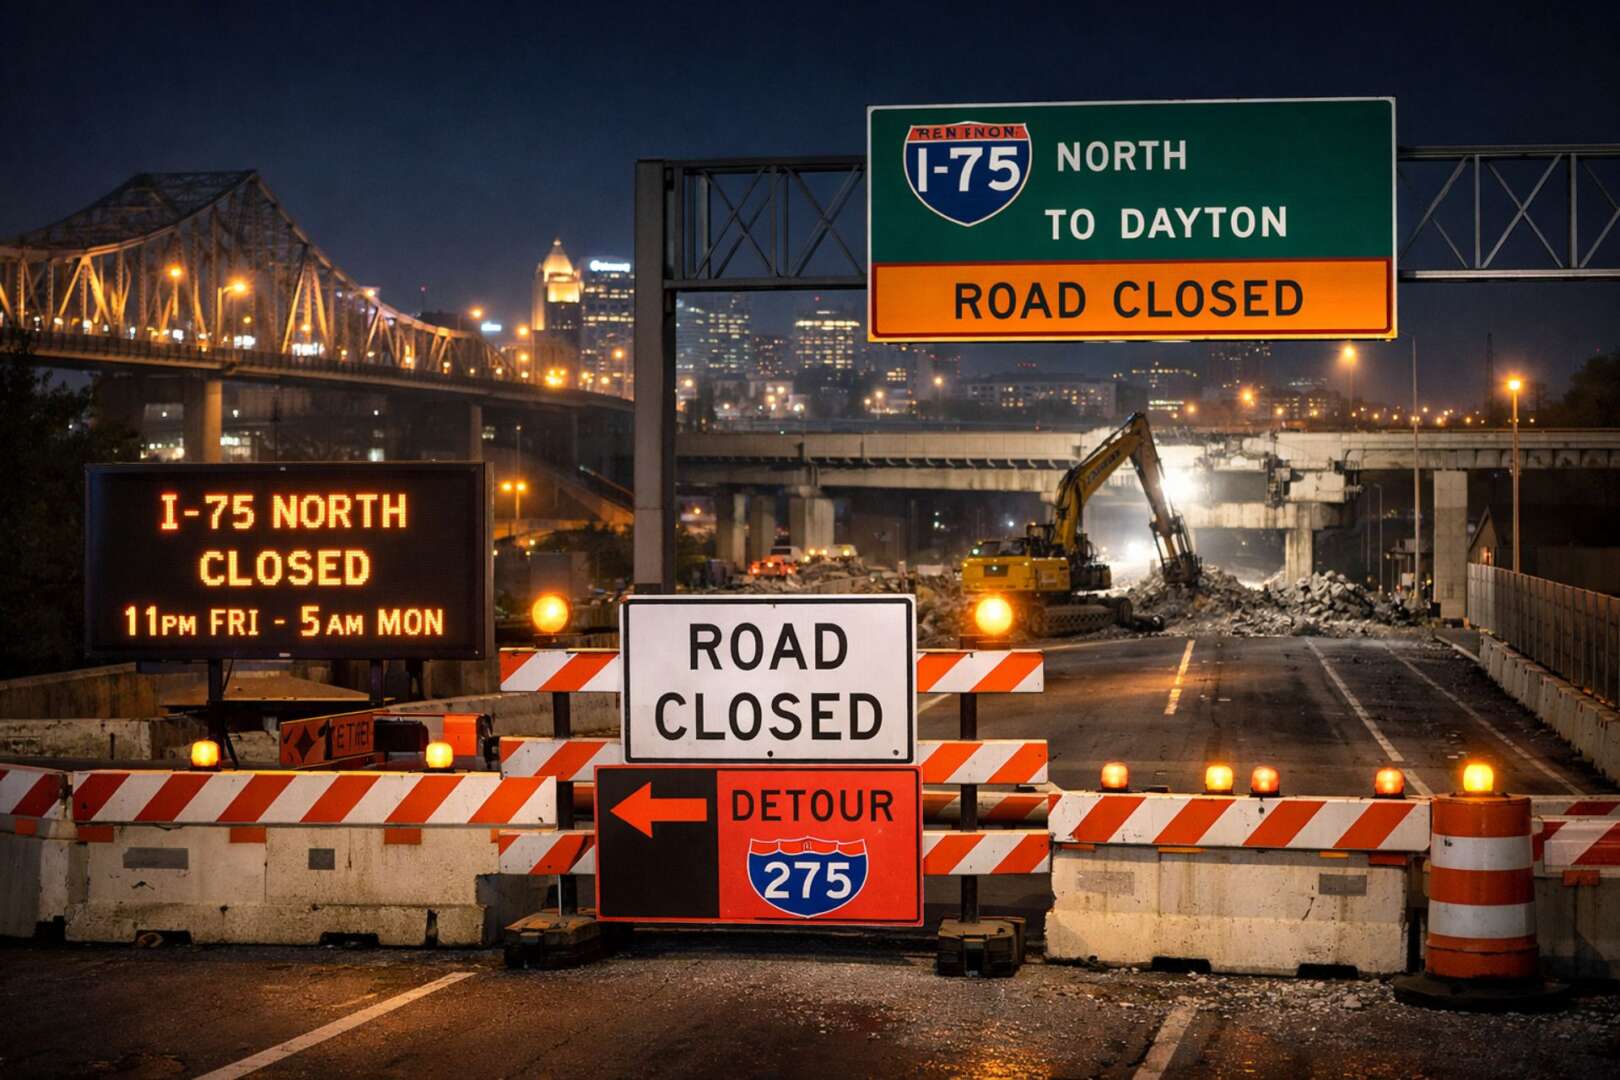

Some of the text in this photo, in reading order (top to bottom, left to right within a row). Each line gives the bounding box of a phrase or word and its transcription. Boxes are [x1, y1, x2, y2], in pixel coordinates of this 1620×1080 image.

[917, 146, 1021, 193] I-75
[1057, 140, 1187, 172] NORTH
[1044, 206, 1288, 241] TO DAYTON
[954, 279, 1304, 320] ROAD CLOSED
[160, 493, 408, 530] I-75 NORTH
[199, 549, 371, 587] CLOSED
[209, 608, 259, 637] FRI
[377, 608, 444, 637] MON
[689, 622, 848, 671] ROAD
[655, 691, 883, 741] CLOSED
[731, 788, 894, 822] DETOUR
[763, 860, 853, 899] 275
